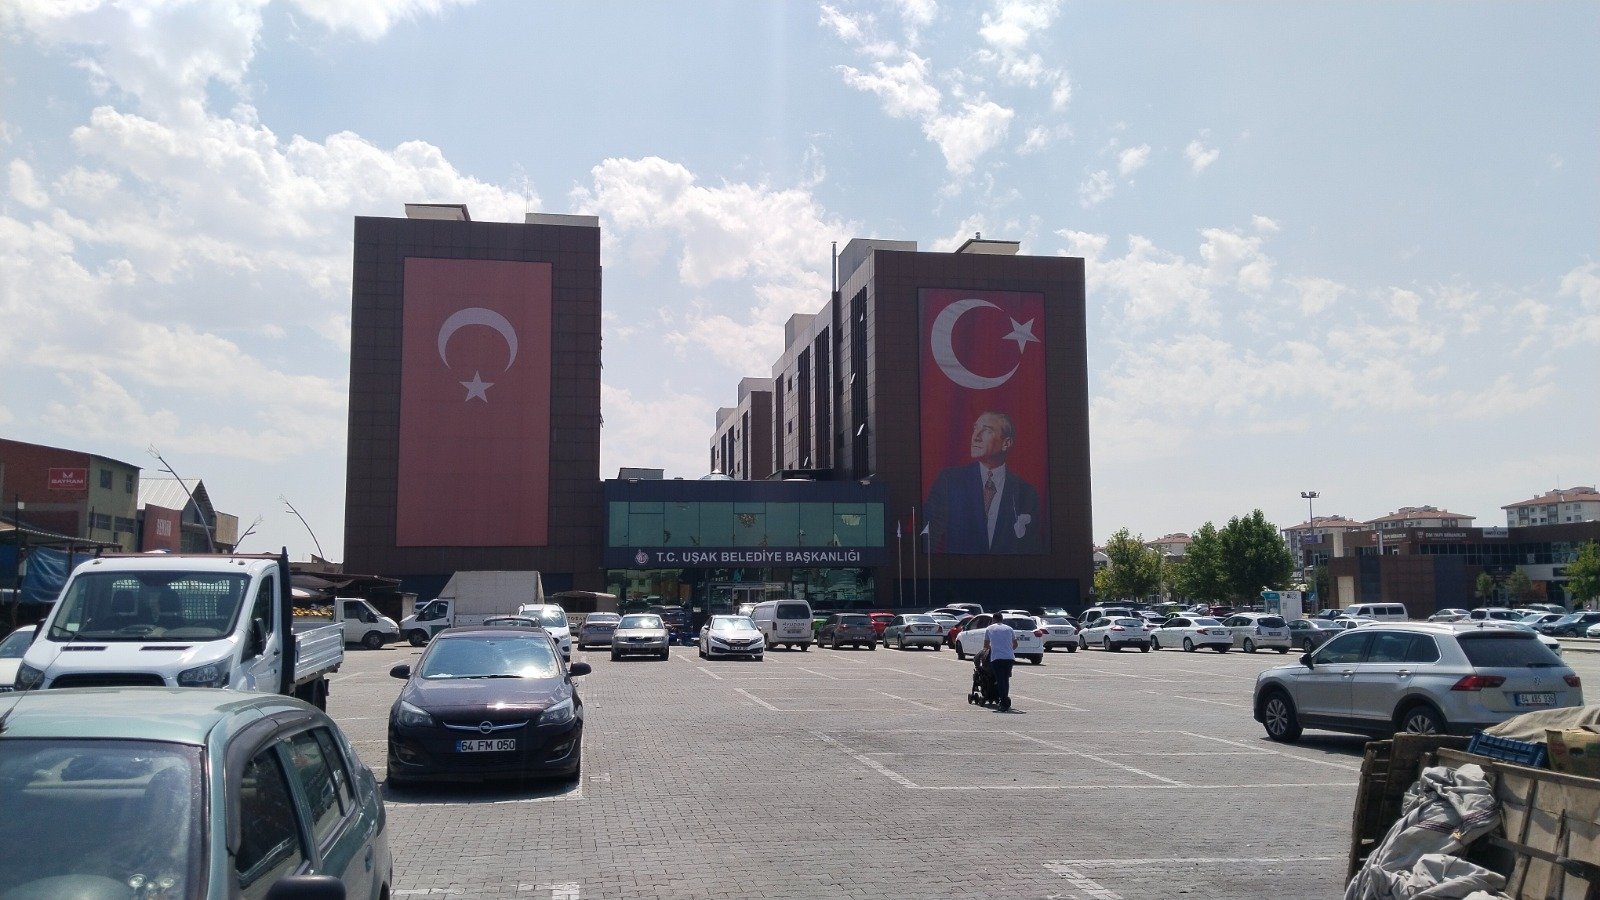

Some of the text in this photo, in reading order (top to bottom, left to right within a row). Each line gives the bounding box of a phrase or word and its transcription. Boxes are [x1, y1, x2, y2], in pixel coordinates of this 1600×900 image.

[656, 549, 860, 564] T.C. UŞAK BELEDİYE BAŞKANLIĞI
[461, 741, 474, 751] 64
[477, 740, 493, 751] FM
[497, 740, 515, 750] 050
